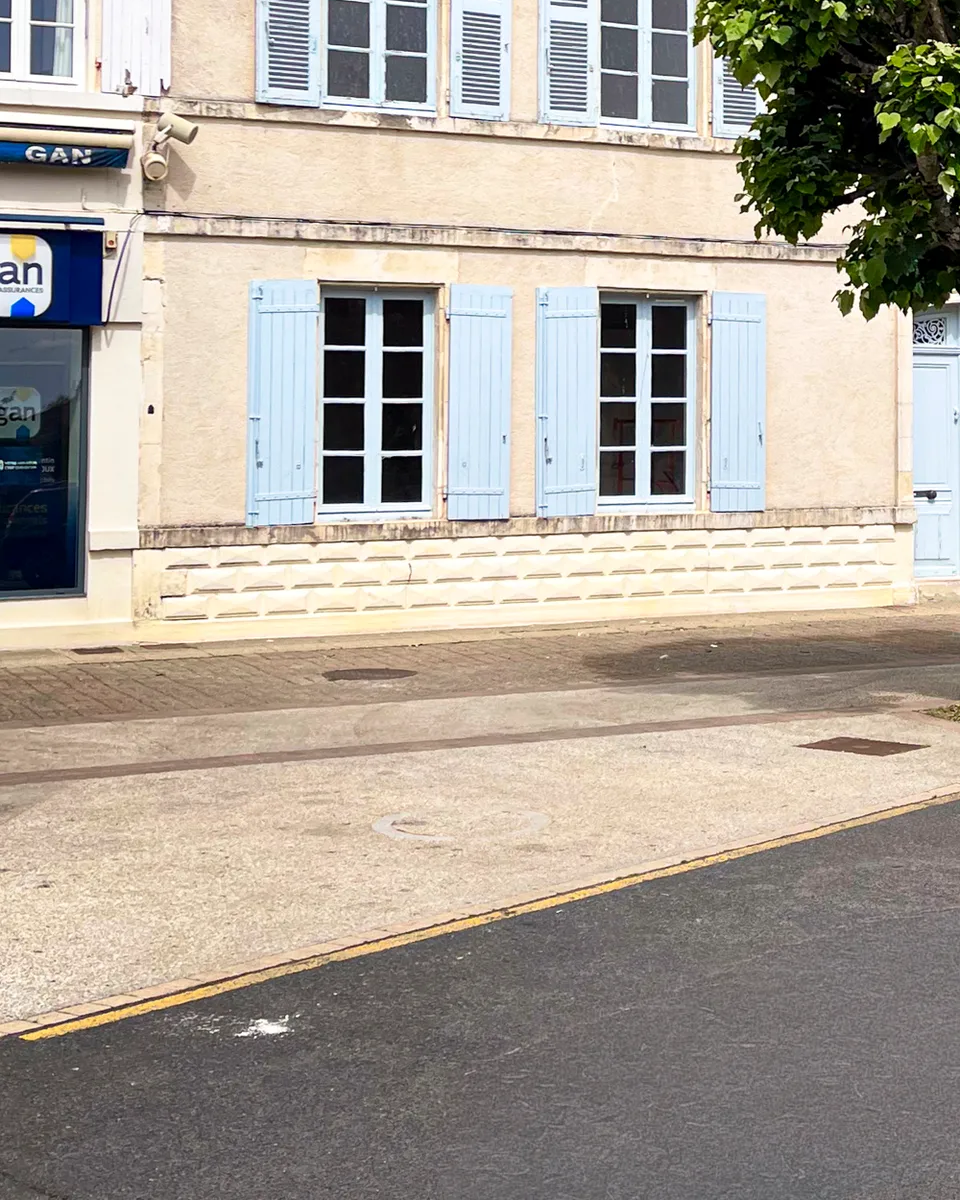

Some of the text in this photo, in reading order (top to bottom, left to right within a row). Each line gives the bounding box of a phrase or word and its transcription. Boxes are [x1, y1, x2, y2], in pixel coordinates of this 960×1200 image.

[25, 145, 92, 165] GAN
[0, 261, 43, 285] an
[0, 406, 36, 426] gan
